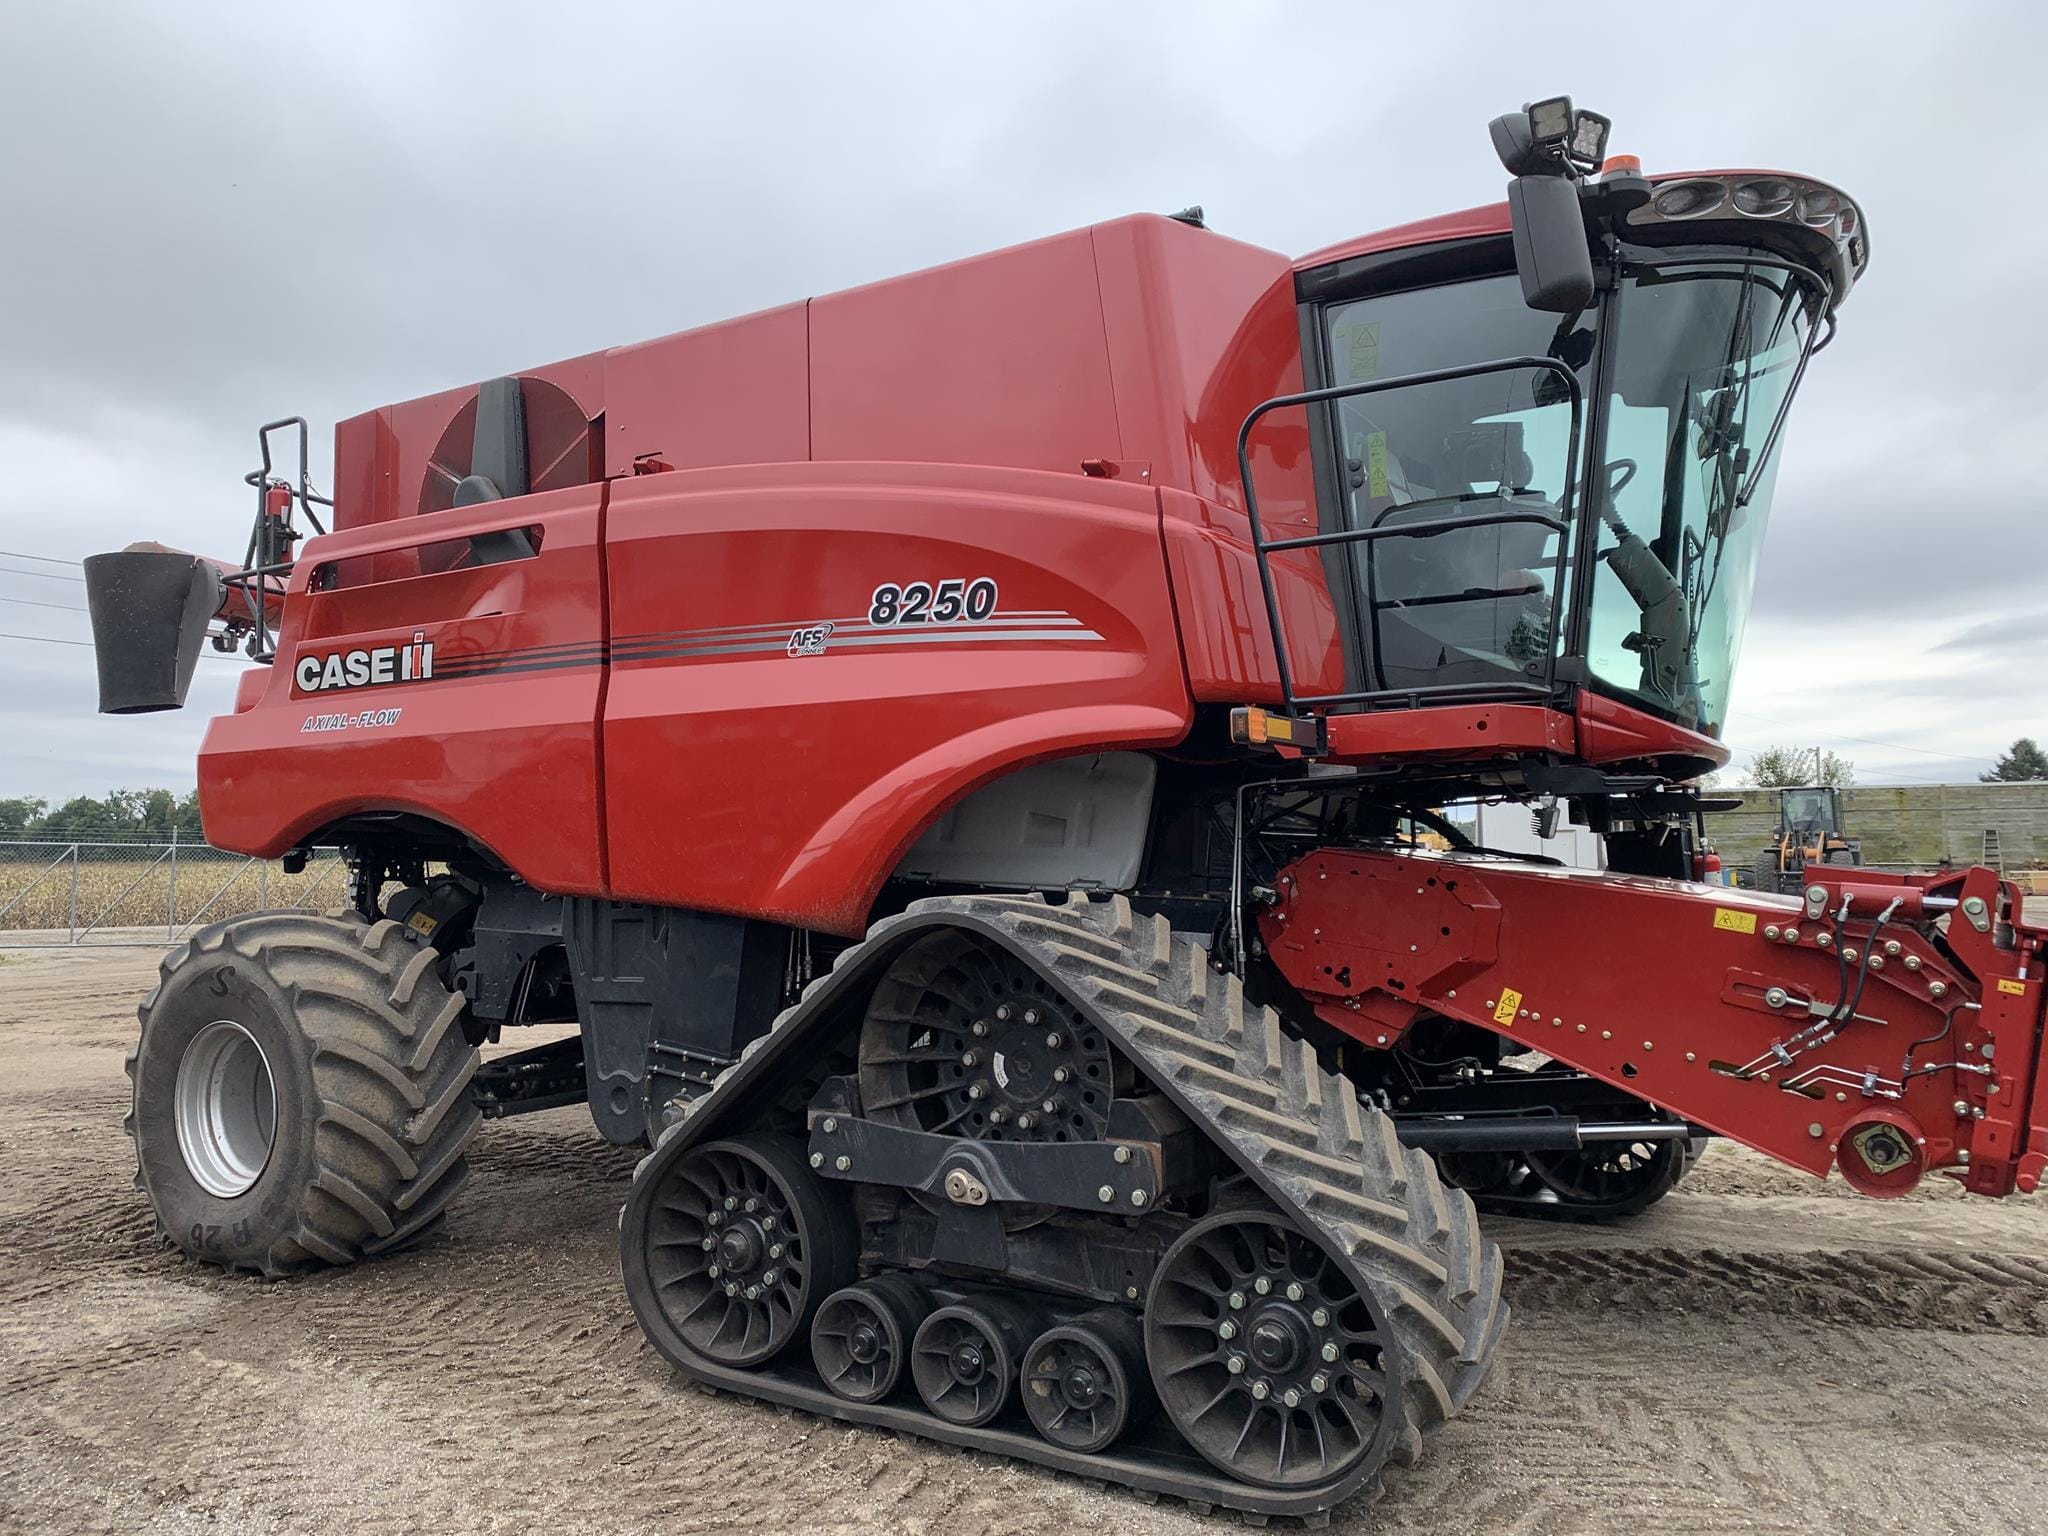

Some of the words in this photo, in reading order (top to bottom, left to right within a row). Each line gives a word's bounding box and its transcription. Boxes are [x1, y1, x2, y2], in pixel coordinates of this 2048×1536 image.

[868, 577, 998, 627] 8250
[787, 629, 825, 648] AFS
[295, 648, 396, 692] CASE
[301, 708, 402, 733] AXIAL-FLOW
